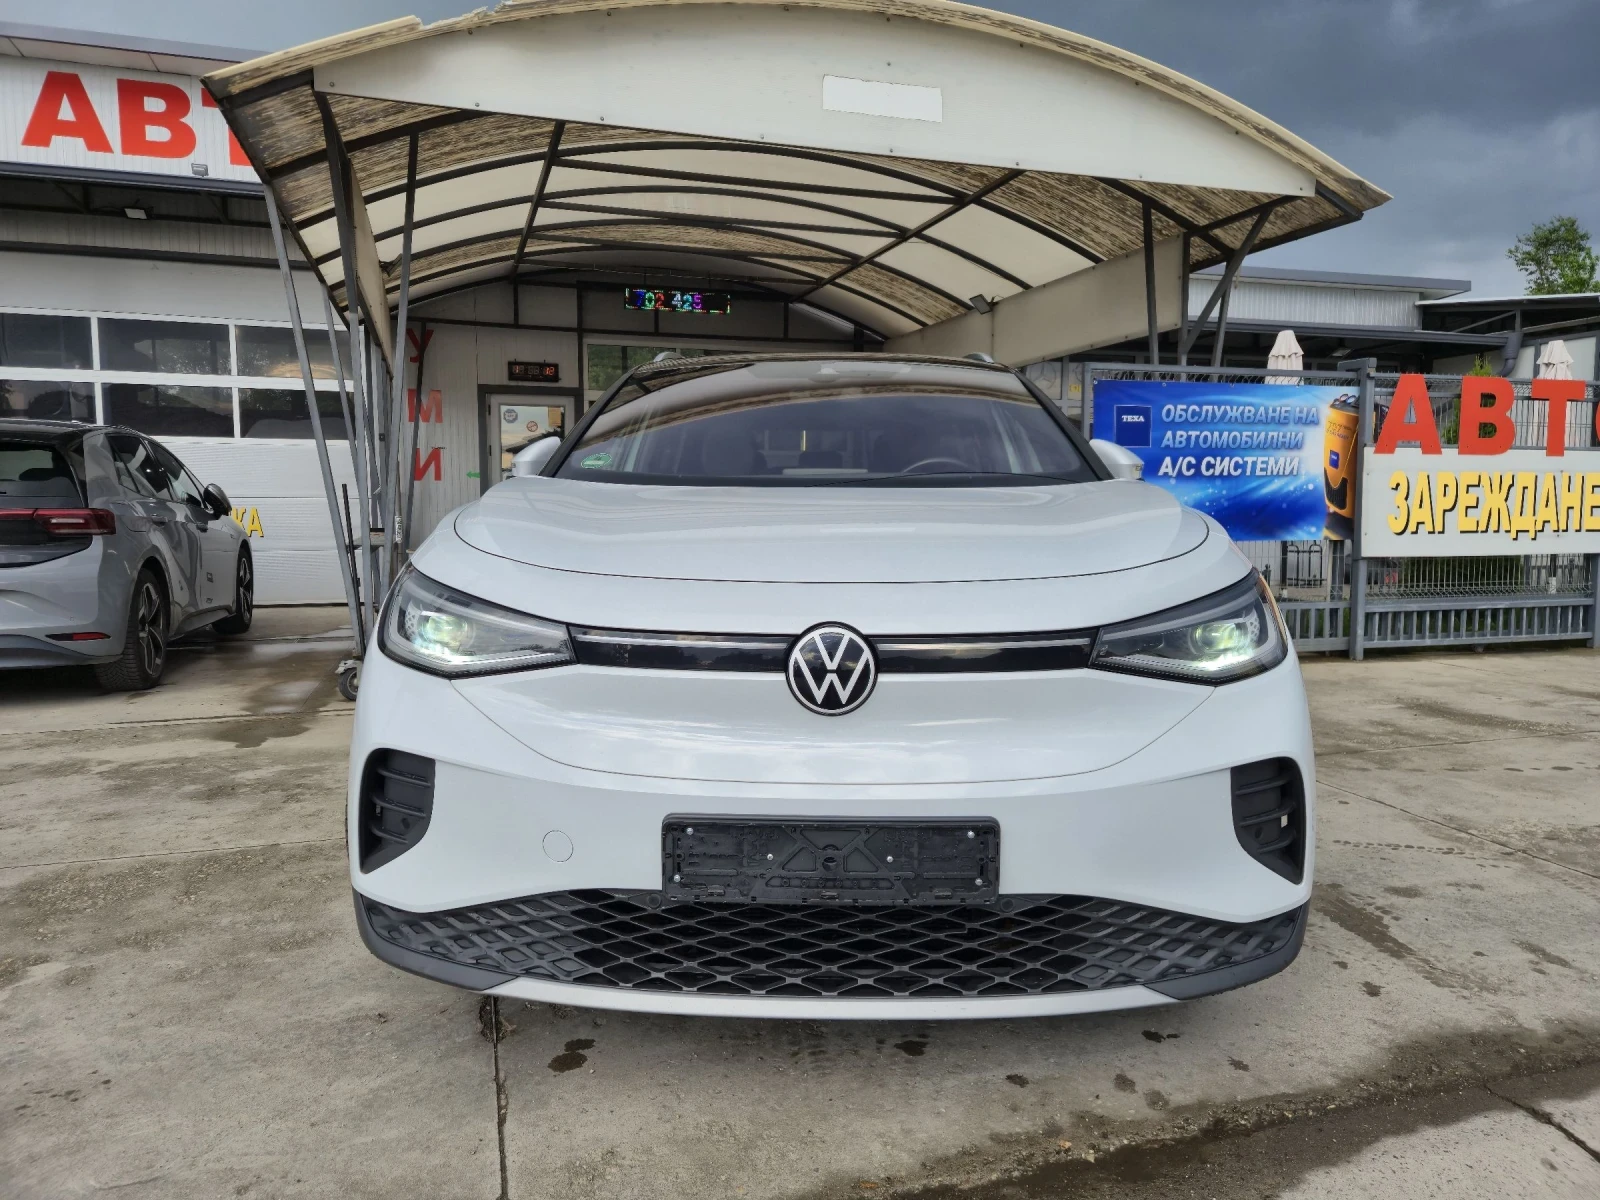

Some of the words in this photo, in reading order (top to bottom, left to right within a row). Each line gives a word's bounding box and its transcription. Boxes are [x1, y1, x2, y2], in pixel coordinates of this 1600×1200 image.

[1121, 414, 1145, 423] TEXA
[1161, 404, 1291, 425] ОБСЛУЖВАНЕ
[1294, 407, 1320, 425] НА
[1373, 373, 1600, 457] АВТ
[1161, 430, 1304, 449] АВТОМОБИЛНИ
[1201, 456, 1300, 476] СИСТЕМИ
[1386, 469, 1600, 541] ЗАРЕЖДАНЕ
[790, 628, 873, 709] VW
